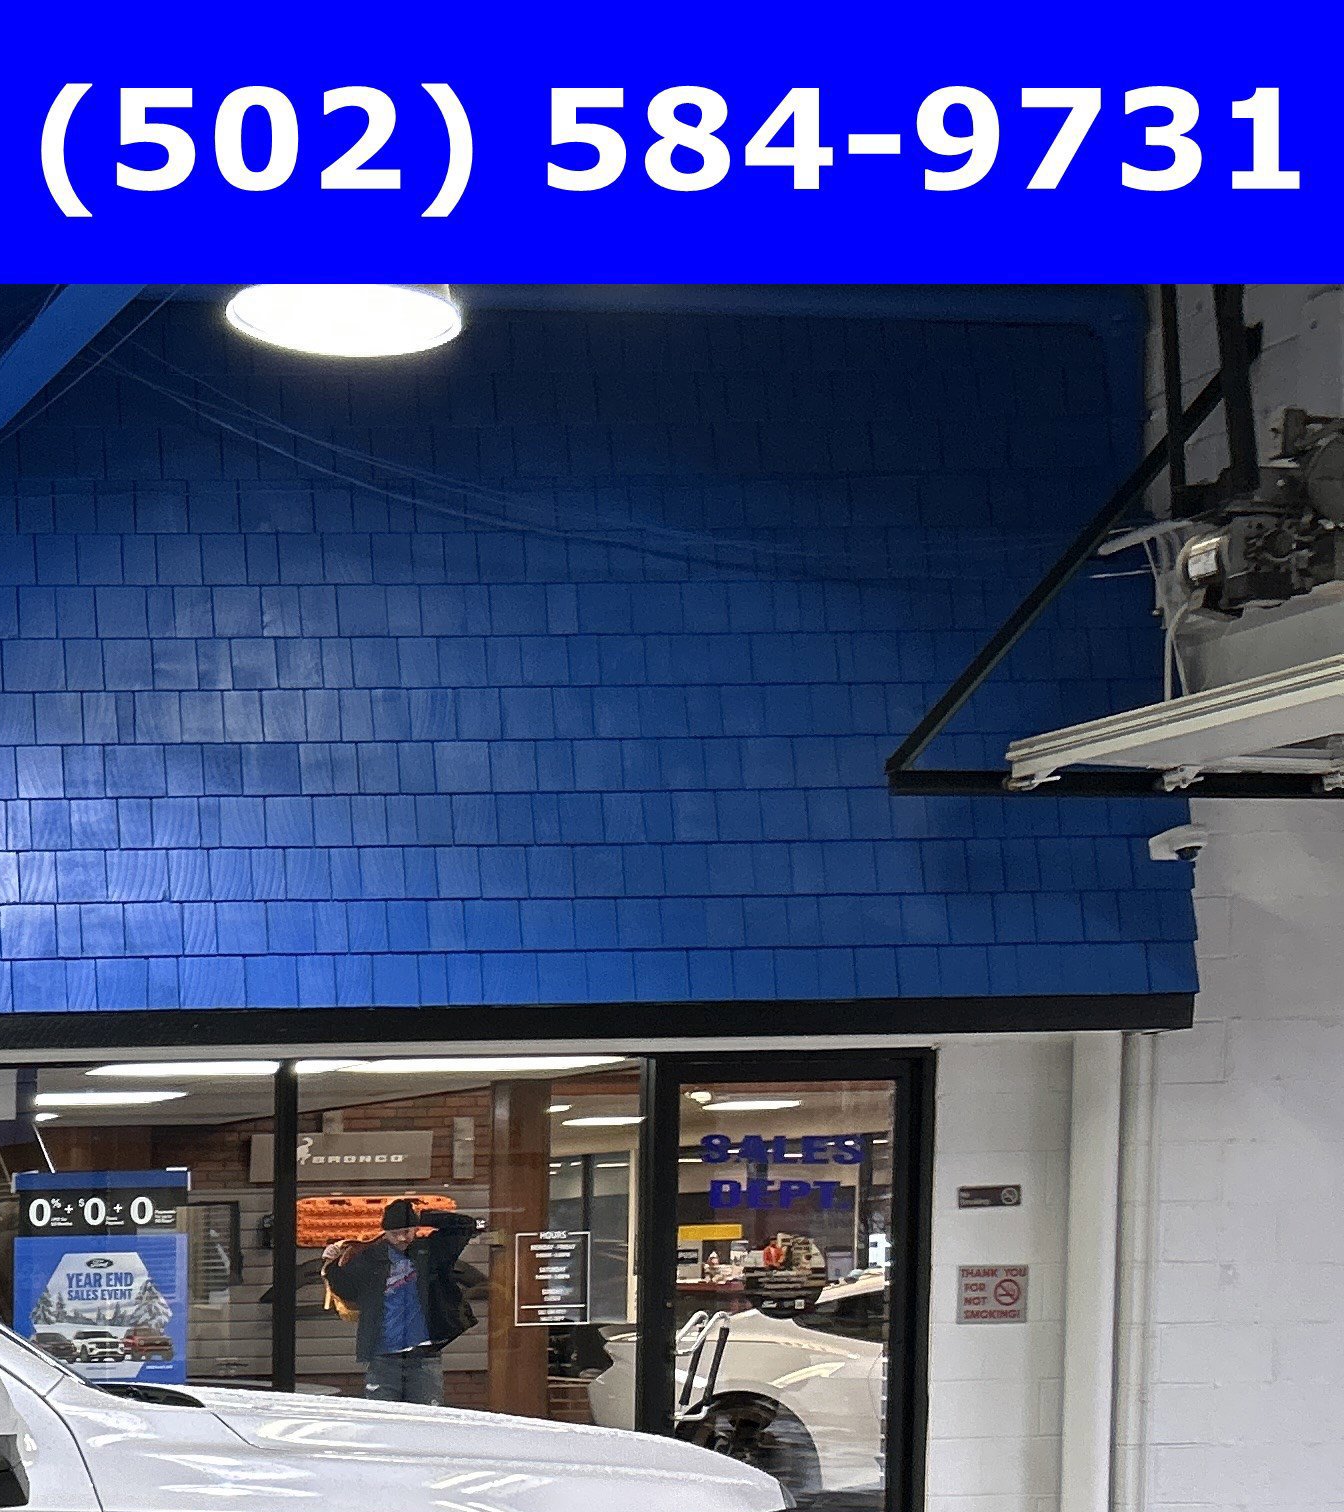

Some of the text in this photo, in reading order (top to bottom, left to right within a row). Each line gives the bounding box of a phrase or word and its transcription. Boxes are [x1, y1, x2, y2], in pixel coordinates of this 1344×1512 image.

[700, 1134, 864, 1164] SALES
[312, 1154, 404, 1164] BRONCO
[961, 1267, 1027, 1278] THANK YOU
[66, 1272, 134, 1288] YEAR END
[964, 1283, 986, 1292] FOR
[67, 1288, 133, 1301] SALES EVENT
[964, 1296, 988, 1306] NOT
